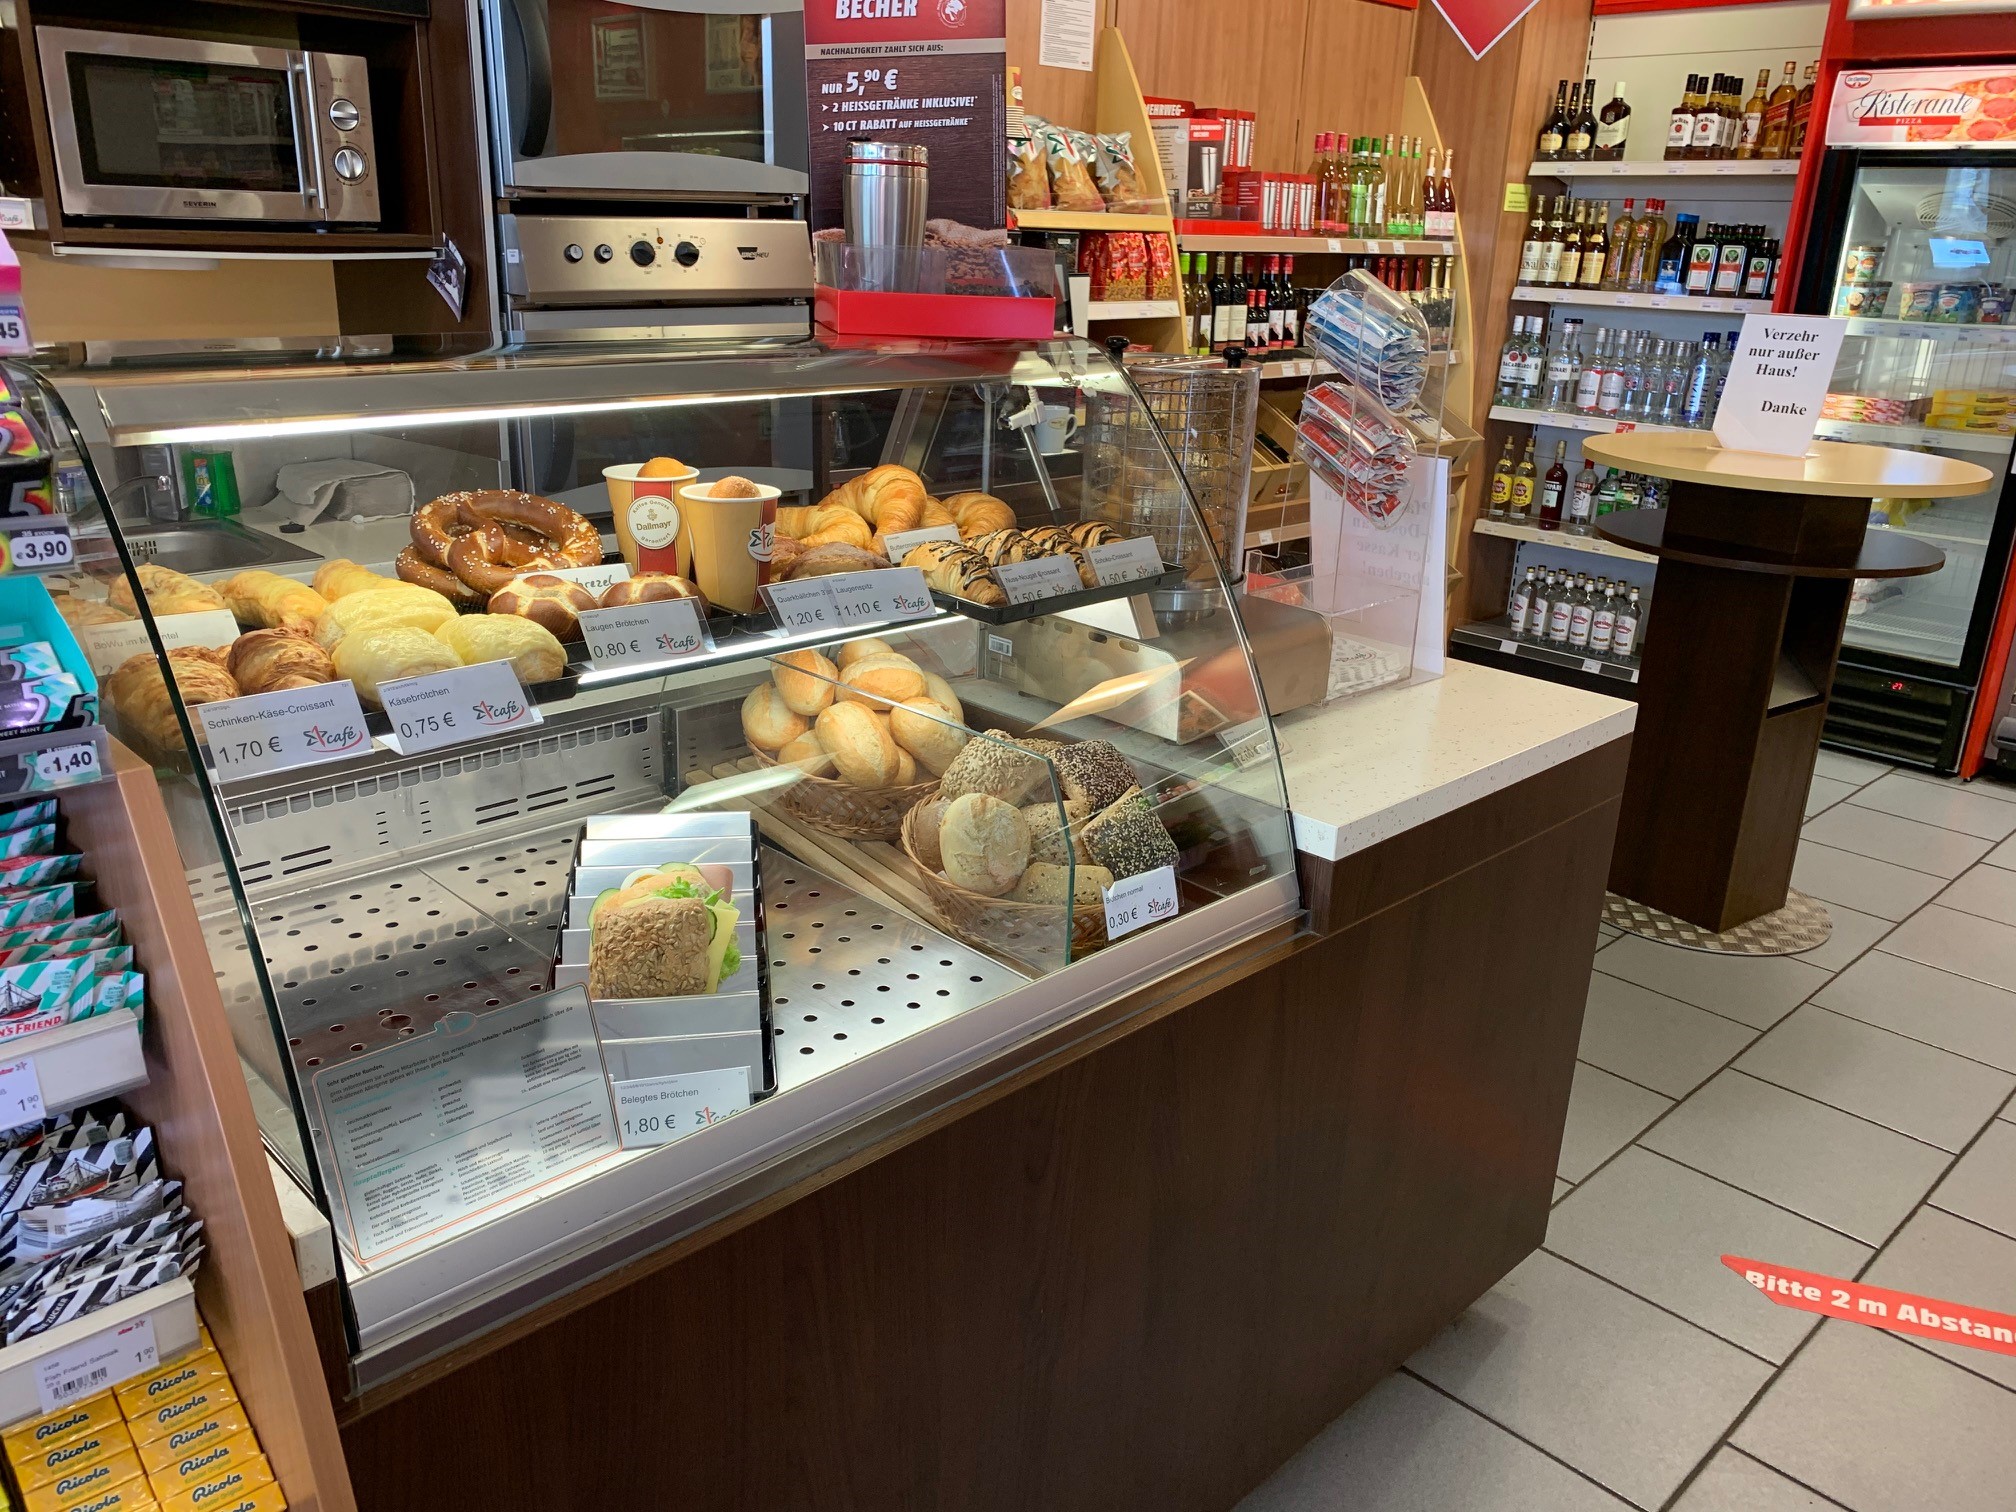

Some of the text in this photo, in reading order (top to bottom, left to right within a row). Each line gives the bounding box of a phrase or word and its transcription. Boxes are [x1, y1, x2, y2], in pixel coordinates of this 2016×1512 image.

[835, 0, 919, 20] BECHER
[820, 44, 944, 56] NACHHALTIGKEIT ZAHLT SICH AUS:
[821, 68, 899, 96] NUR 5,90 €
[832, 102, 838, 113] 2
[841, 97, 919, 112] HEISSGETRÄNKE
[1851, 88, 1976, 121] Ristorante
[833, 121, 844, 132] 10
[845, 120, 857, 131] CT
[859, 118, 898, 131] RABATT
[898, 121, 913, 129] AUF
[1895, 117, 1923, 125] PIZZA
[1764, 328, 1819, 343] Verzehr
[1748, 347, 1820, 361] nur außer
[1756, 363, 1798, 378] Haus!
[1761, 400, 1807, 416] Danke
[636, 520, 672, 532] Dallmayr
[640, 532, 671, 544] garantiert
[15, 540, 68, 560] € 3,90
[1094, 551, 1134, 565] Schoko-Croissant
[1005, 571, 1038, 584] Nuss-Nougat
[1101, 570, 1128, 587] 1,50 €
[777, 589, 821, 605] Quarkbällchen
[835, 582, 874, 596] Laugenspitz
[1013, 589, 1043, 604] 1,50 €
[843, 601, 882, 618] 1,10 €
[906, 598, 928, 613] café
[584, 616, 650, 634] Laugen Brötchen
[786, 608, 825, 628] 1,20 €
[93, 637, 124, 650] BoWu
[138, 632, 179, 645] Mntel
[592, 639, 642, 660] 0,80 €
[673, 634, 696, 653] café
[388, 687, 450, 708] Käsebrötchen
[207, 698, 335, 730] Schinken-Käse-Croissant
[493, 700, 521, 721] café
[20, 725, 41, 734] MINT
[399, 711, 457, 740] 0,75 €
[325, 725, 356, 747] café
[218, 735, 283, 766] 1,70 €
[44, 750, 92, 775] € 1,40
[1127, 885, 1144, 896] normal
[1157, 897, 1172, 911] café
[1108, 907, 1138, 929] 0,30 €
[15, 1015, 62, 1035] FRIEND
[620, 1088, 699, 1105] Belegtes Brötchen
[623, 1114, 676, 1136] 1,80 €
[46, 1296, 69, 1325] ZUCKER
[1745, 1270, 2016, 1344] Bitte 2 m Abstan
[147, 1367, 197, 1397] Ricola
[157, 1393, 208, 1424] Ricola
[35, 1410, 90, 1441] Ricola
[169, 1420, 219, 1451] Ricola
[46, 1437, 101, 1468] Ricola
[179, 1446, 230, 1477] Ricola
[56, 1465, 111, 1496] Ricola
[191, 1472, 243, 1504] Ricola
